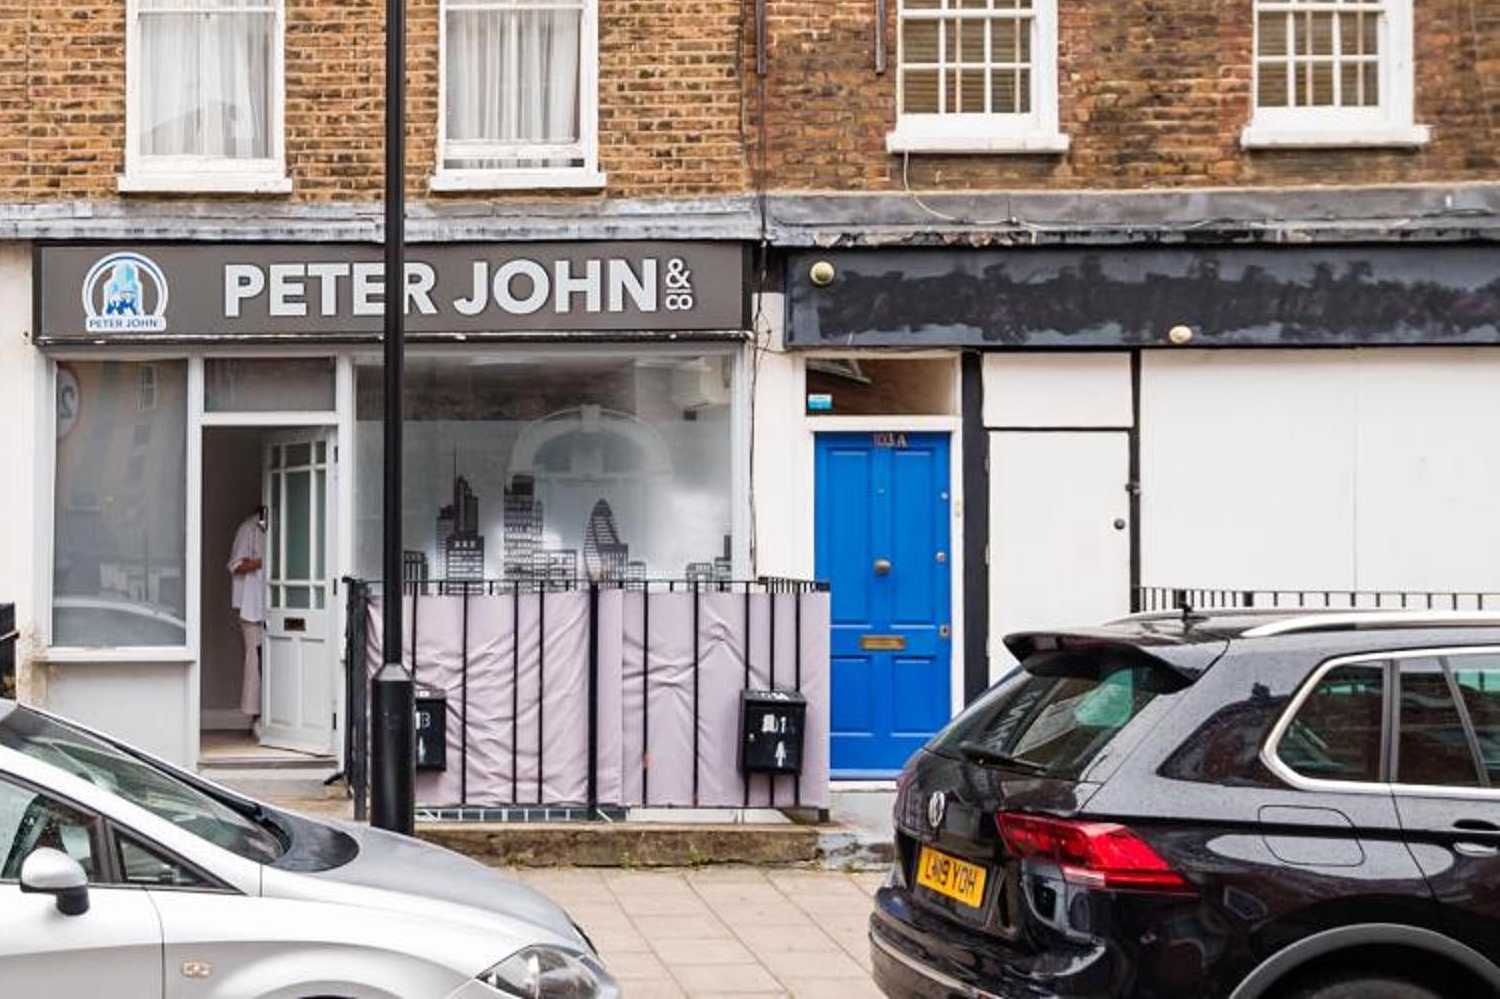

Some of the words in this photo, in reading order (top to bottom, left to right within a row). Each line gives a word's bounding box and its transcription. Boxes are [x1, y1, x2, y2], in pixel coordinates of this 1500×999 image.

[224, 263, 438, 317] PETER
[453, 258, 657, 316] JOHN
[89, 319, 123, 329] PETER
[126, 318, 157, 329] JOHN
